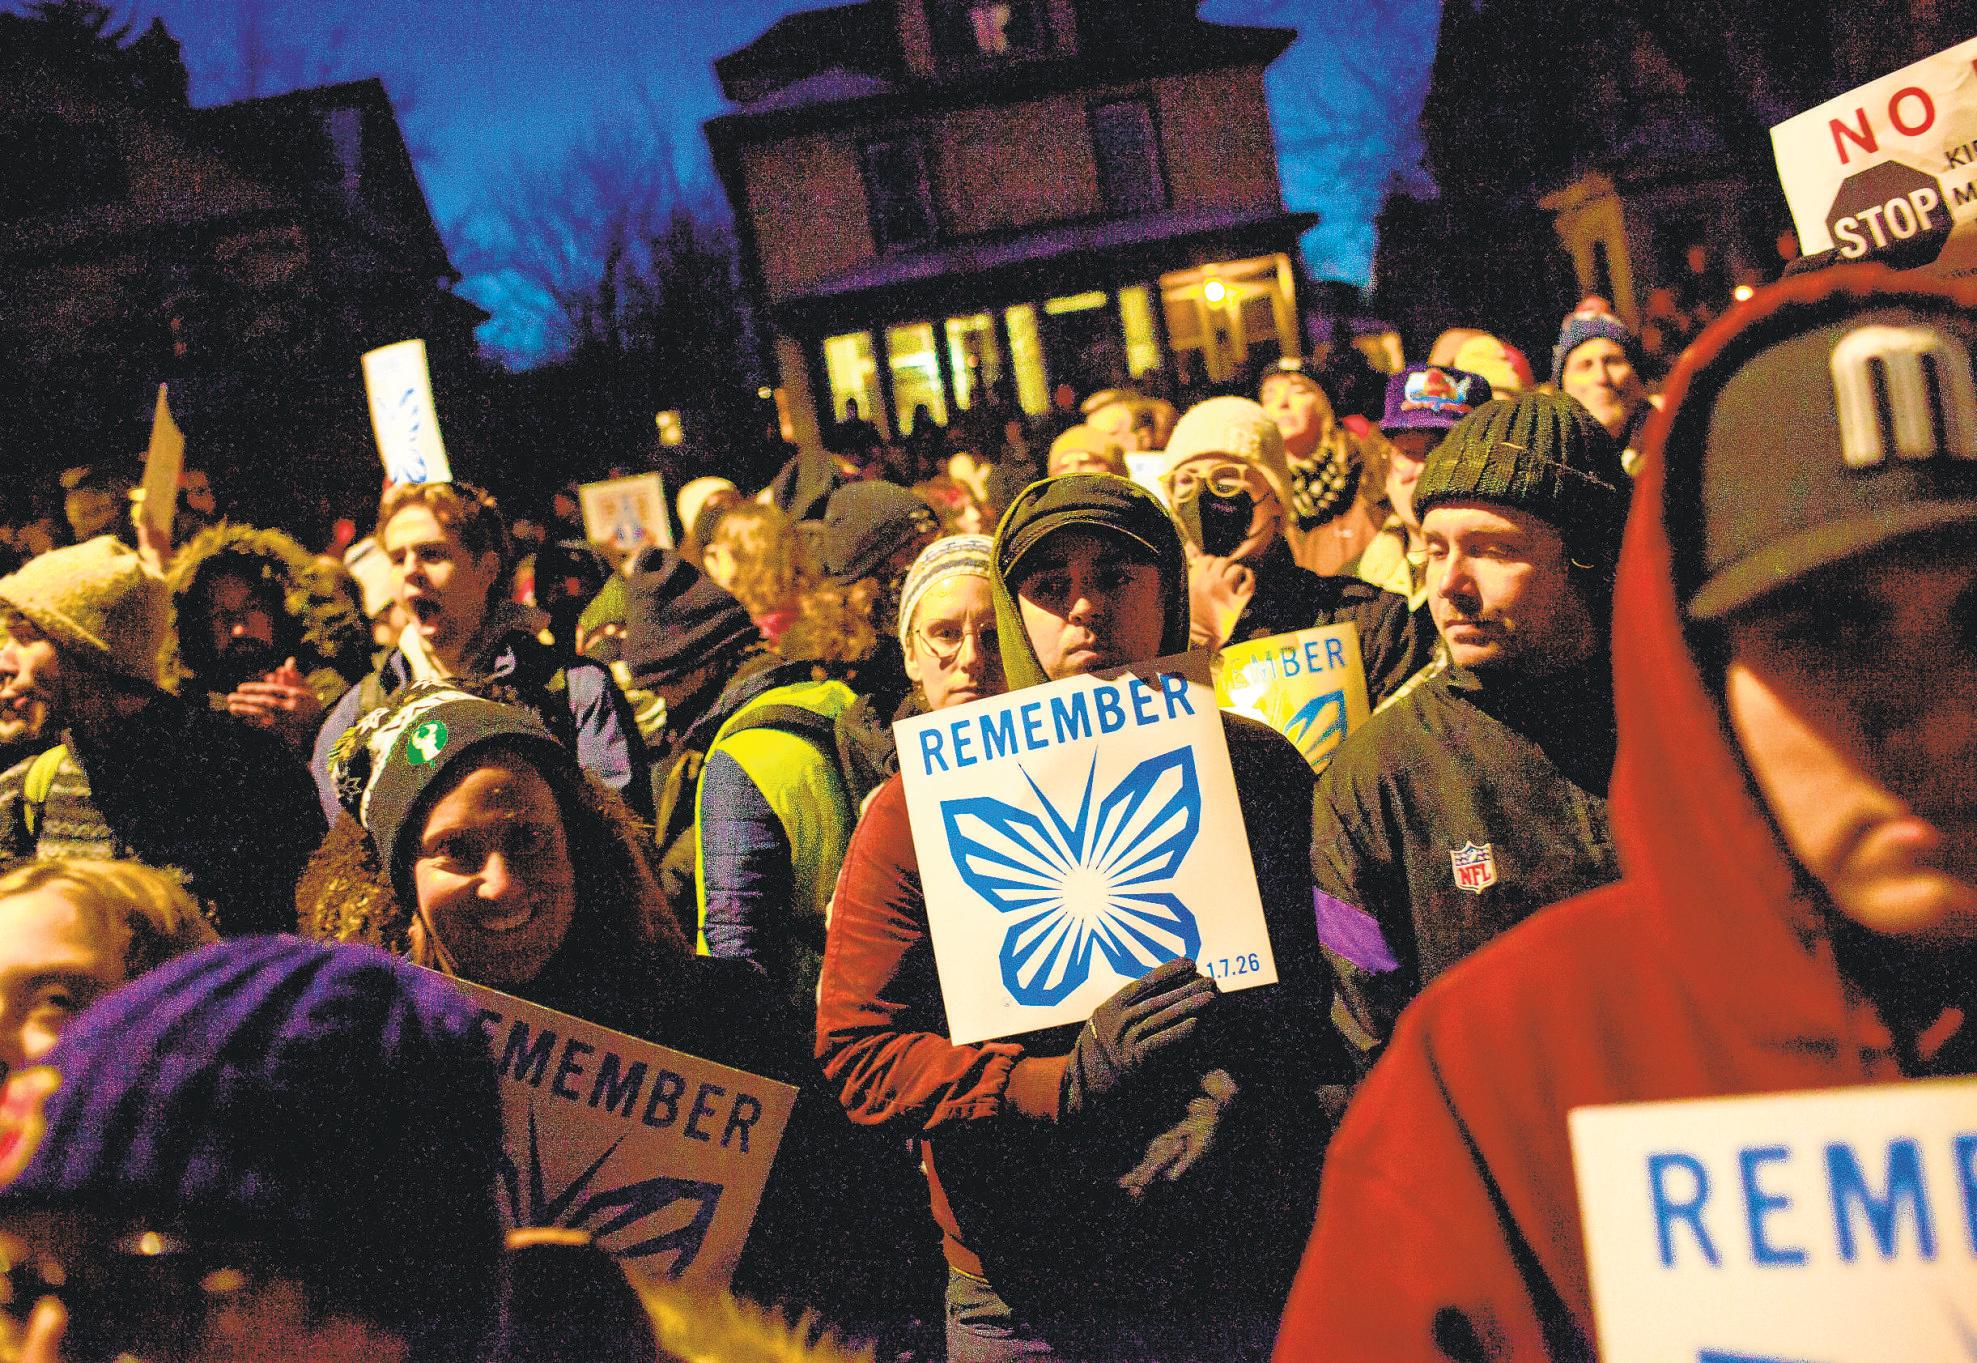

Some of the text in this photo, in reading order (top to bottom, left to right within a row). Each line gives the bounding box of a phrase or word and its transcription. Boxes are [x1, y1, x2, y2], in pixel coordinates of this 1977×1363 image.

[1829, 87, 1935, 165] NO
[1833, 187, 1939, 258] STOP
[919, 672, 1196, 775] REMEMBER
[1457, 863, 1491, 886] NFL
[1206, 952, 1260, 978] 1.7.26
